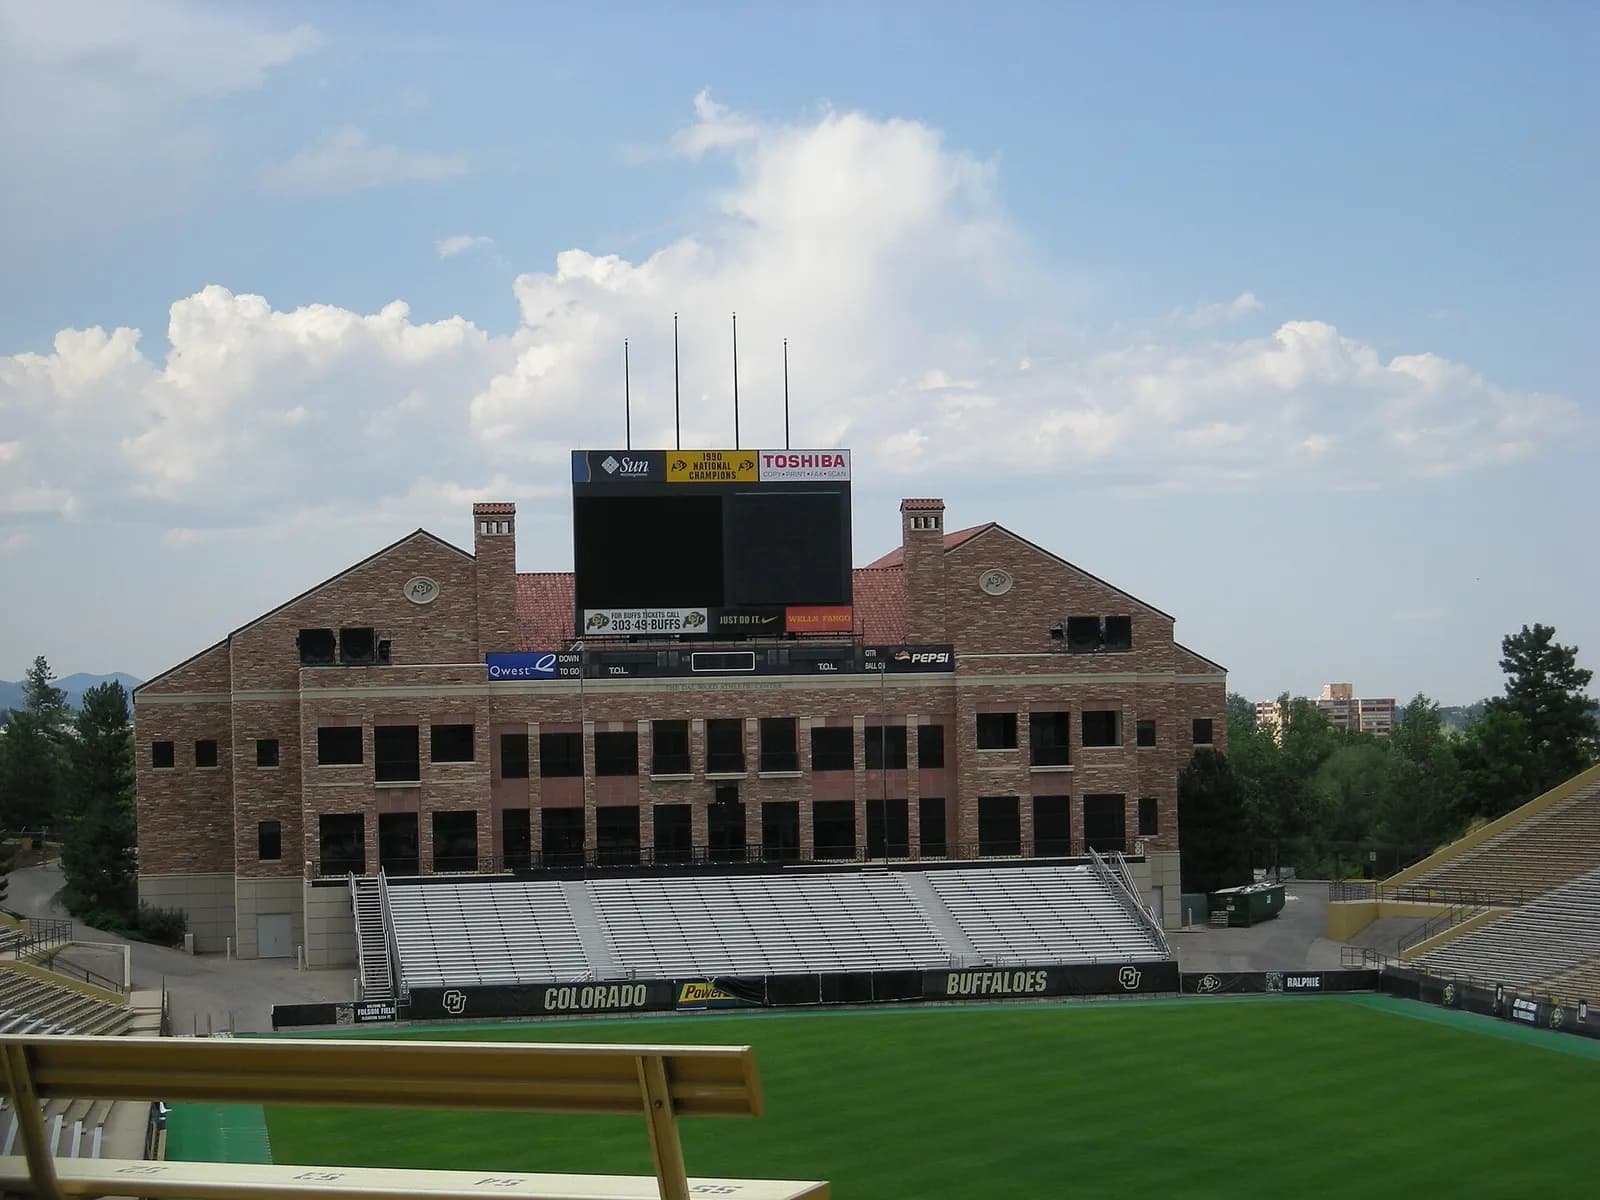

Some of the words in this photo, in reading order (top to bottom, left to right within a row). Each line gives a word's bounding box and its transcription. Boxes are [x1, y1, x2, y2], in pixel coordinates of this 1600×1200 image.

[703, 452, 723, 461] 1990
[762, 454, 846, 468] TOSHIBA
[620, 456, 649, 473] Sun
[693, 461, 732, 471] NATIONAL
[688, 470, 737, 480] CHAMPIONS
[623, 611, 641, 619] BUFFS
[719, 615, 738, 625] JUST
[739, 615, 750, 624] DO
[788, 615, 819, 623] WELLS
[822, 614, 851, 622] FARGO
[611, 618, 681, 631] 303-49-BUFFS
[558, 655, 580, 663] DOWN
[911, 652, 950, 664] PEPSI
[560, 667, 569, 675] TO
[569, 667, 580, 675] GO
[864, 662, 878, 670] BALL
[489, 665, 532, 678] Qwest
[946, 970, 1049, 995] BUFFALOES
[1287, 976, 1320, 988] RALPHIE
[544, 983, 648, 1010] COLORADO
